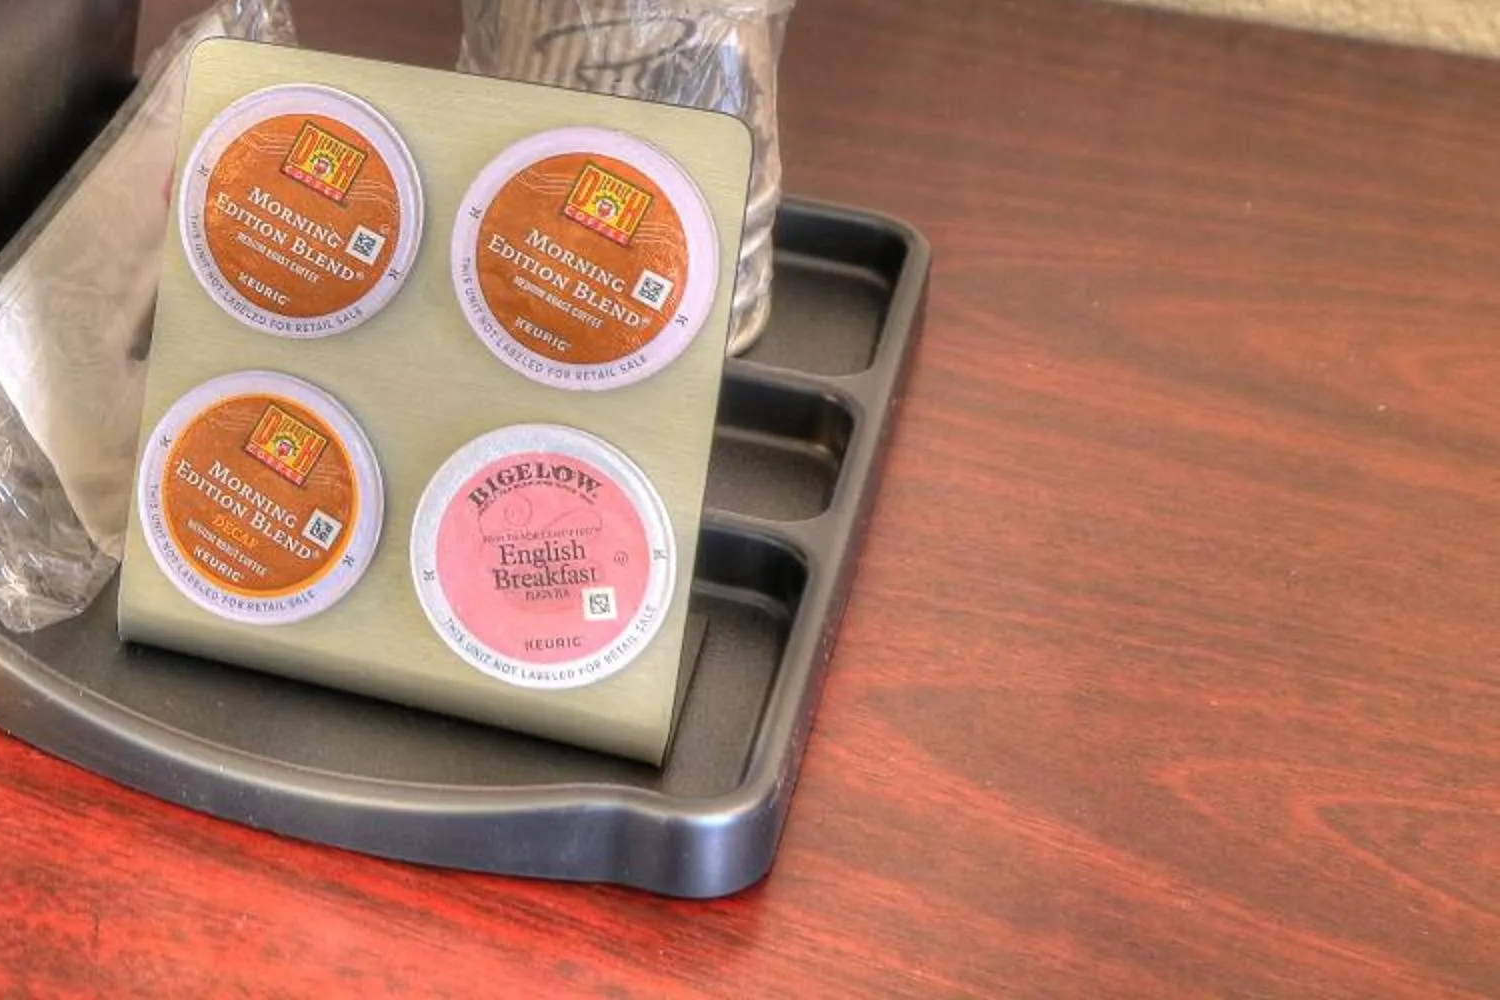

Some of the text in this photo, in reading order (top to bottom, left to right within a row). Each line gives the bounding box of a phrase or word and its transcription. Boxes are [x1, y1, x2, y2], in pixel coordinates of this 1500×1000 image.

[215, 191, 356, 281] EDITION BLEND
[248, 185, 342, 249] MORNING
[487, 233, 641, 327] EDITION BLEND
[524, 227, 627, 293] MORNING
[238, 271, 289, 305] KEURIG
[515, 315, 569, 351] KEURIG
[209, 459, 298, 529] MORNING
[468, 461, 604, 509] BIGELOW
[176, 458, 312, 559] EDITION BLEND
[212, 514, 258, 548] DECAF
[194, 545, 242, 582] KEURIG
[499, 539, 586, 568] English
[492, 563, 597, 590] Breakfast
[525, 636, 583, 651] KEURIG
